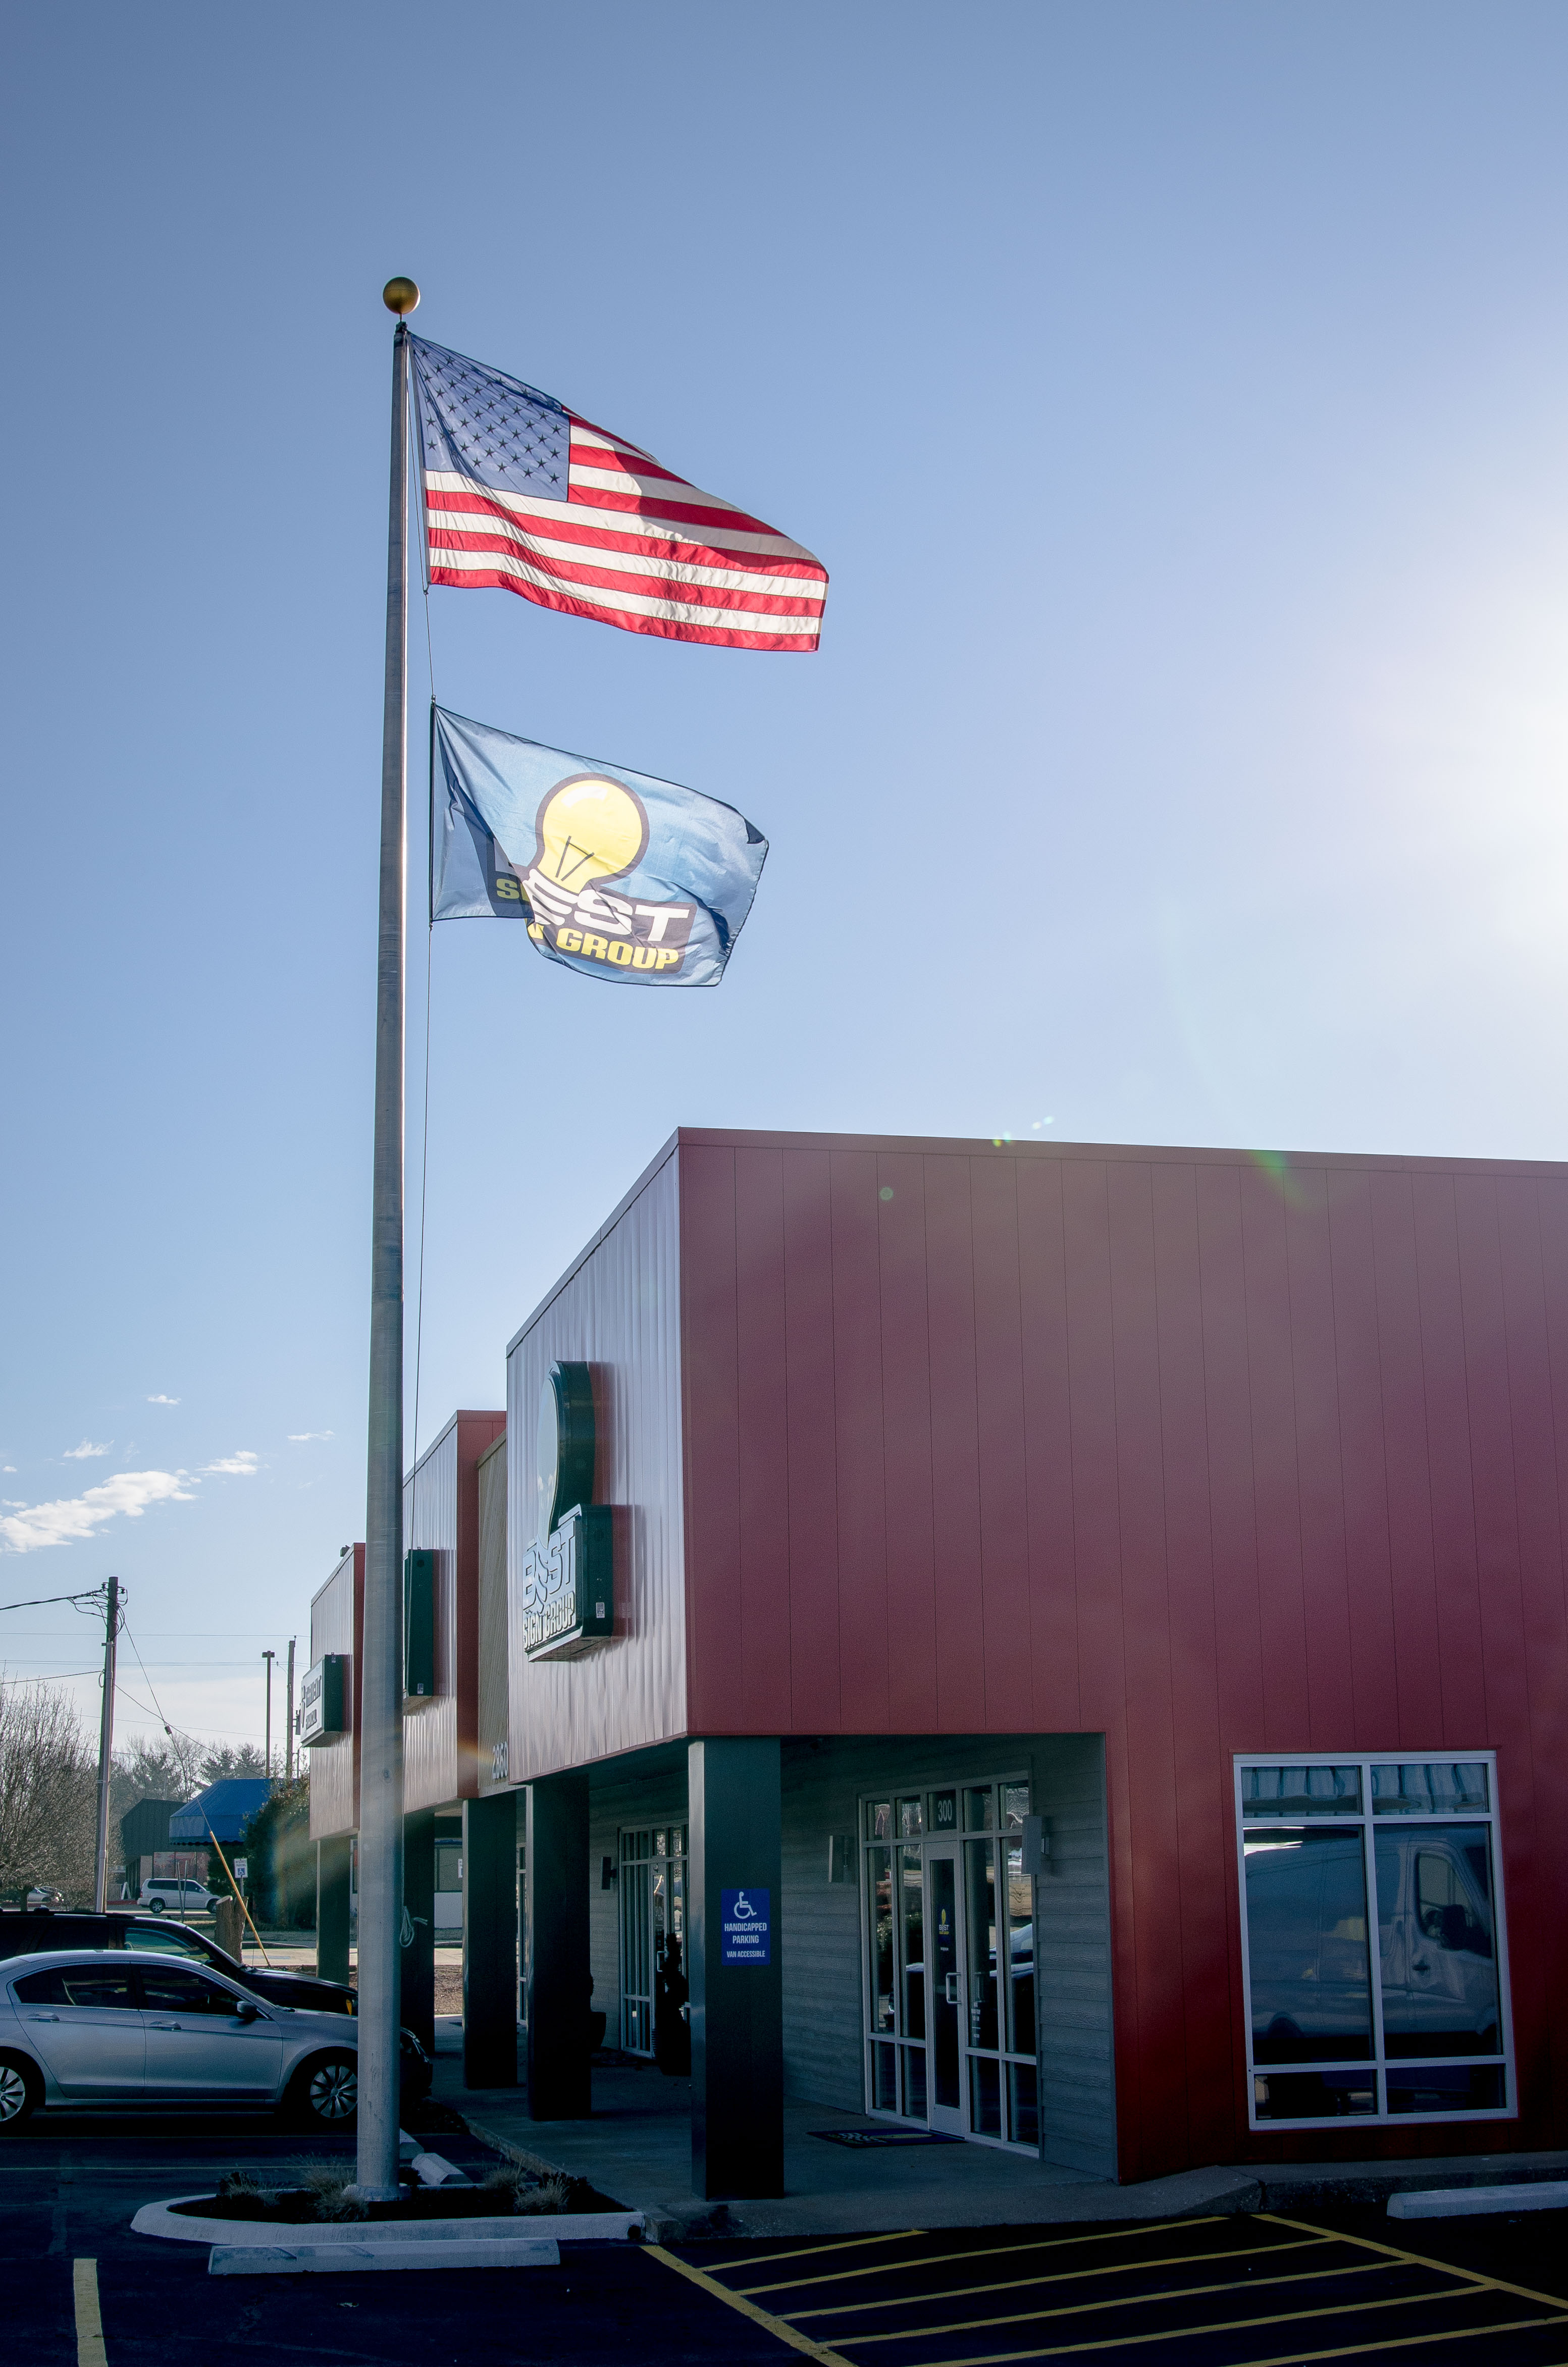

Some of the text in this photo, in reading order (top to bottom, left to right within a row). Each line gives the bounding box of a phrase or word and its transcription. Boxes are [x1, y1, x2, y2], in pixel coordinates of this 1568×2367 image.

[556, 928, 679, 970] GROUP
[522, 1520, 574, 1614] BEST
[523, 1591, 575, 1650] SIGN GROUP
[493, 1741, 508, 1779] 2860
[938, 1799, 952, 1822] 300
[724, 1923, 767, 1931] HANDICAPPED
[733, 1935, 759, 1943] PARKING
